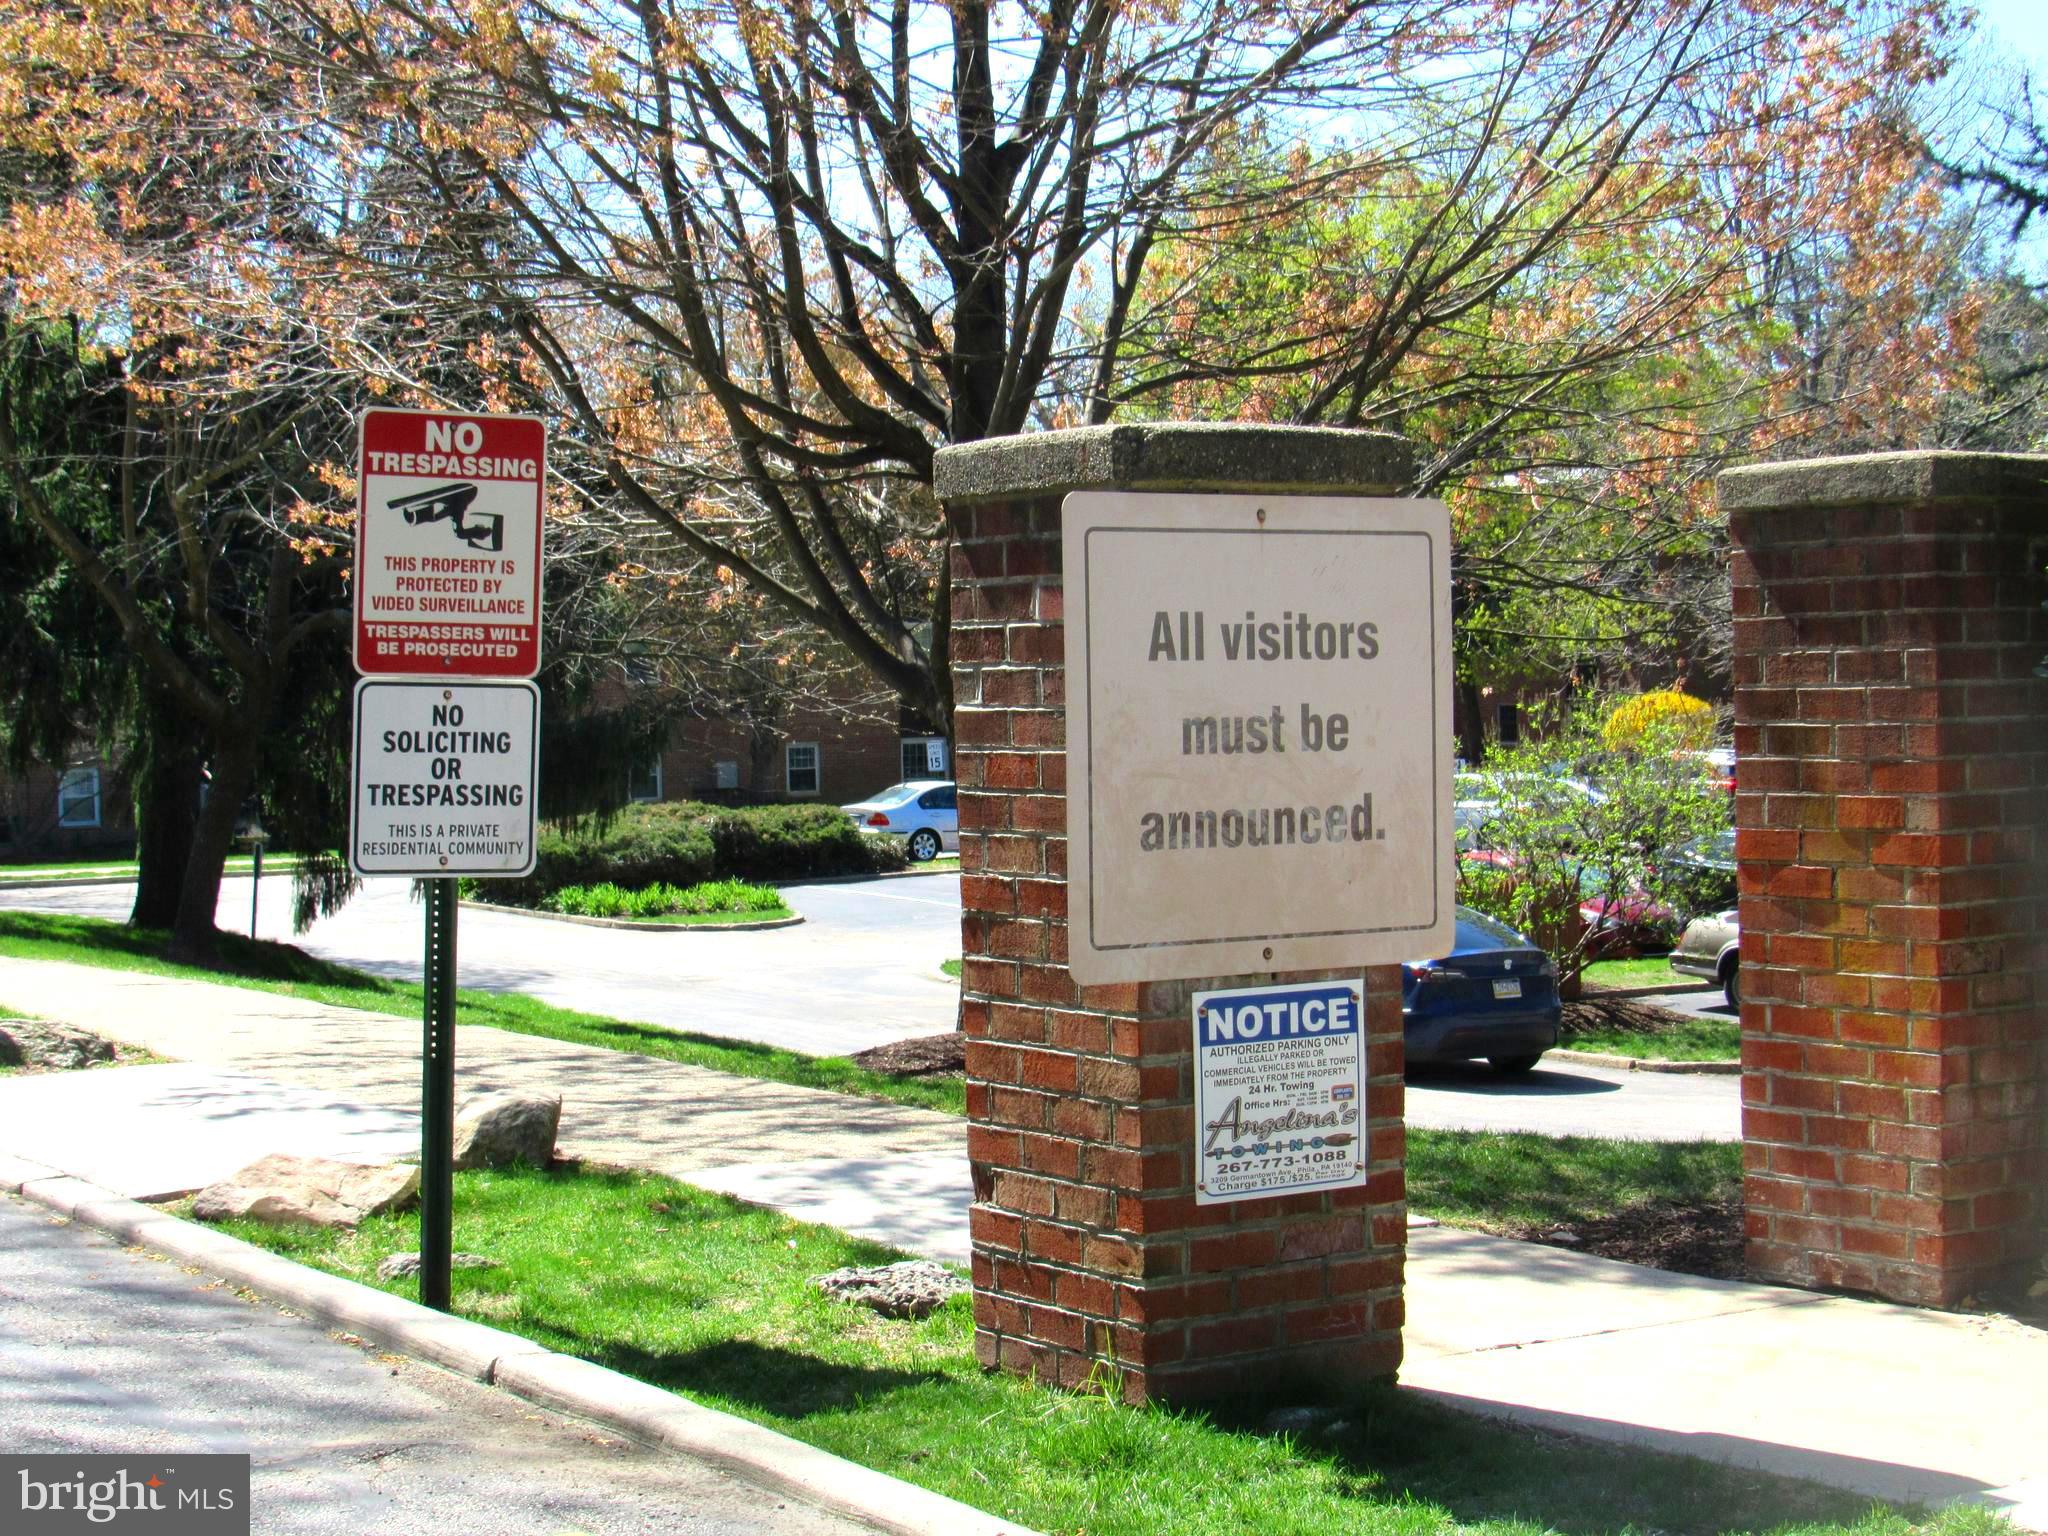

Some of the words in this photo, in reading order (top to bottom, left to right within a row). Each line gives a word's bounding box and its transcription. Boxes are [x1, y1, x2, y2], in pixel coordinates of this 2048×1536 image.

[425, 420, 483, 454] NO
[368, 451, 537, 478] TRESPASSING
[384, 556, 417, 572] THIS
[421, 557, 496, 574] PROPERTY
[501, 560, 515, 574] IS
[396, 577, 478, 593] PROTECTED
[483, 579, 502, 594] BY
[372, 596, 414, 611] VIDEO
[419, 597, 525, 614] SURVEILLANCE
[365, 624, 485, 640] TRESPASSERS
[490, 628, 530, 641] WILL
[1148, 610, 1204, 662] All
[1220, 610, 1379, 661] visitors
[377, 642, 399, 655] BE
[404, 643, 518, 657] PROSECUTED
[433, 704, 464, 727] NO
[1182, 705, 1285, 755] must
[1300, 703, 1349, 752] be
[383, 730, 511, 754] SOLICITING
[431, 757, 462, 780] OR
[930, 757, 941, 768] 15
[368, 784, 523, 807] TRESPASSING
[389, 824, 417, 837] THIS
[421, 824, 432, 837] IS
[437, 824, 445, 837] A
[450, 824, 499, 837] PRIVATE
[1140, 792, 1385, 852] announced.
[362, 842, 443, 855] RESIDENTIAL
[448, 842, 524, 855] COMMUNITY
[1208, 998, 1350, 1041] NOTICE
[1210, 1044, 1275, 1057] AUTHORIZED
[1278, 1039, 1321, 1051] PARKING
[1324, 1035, 1350, 1046] ONLY
[1237, 1055, 1278, 1064] ILLEGALLY
[1280, 1051, 1311, 1060] PARKED
[1313, 1049, 1324, 1057] OR
[1204, 1067, 1256, 1078] COMMERCIAL
[1258, 1063, 1295, 1073] VEHICLES
[1296, 1060, 1315, 1069] WILL
[1317, 1059, 1328, 1067] BE
[1329, 1056, 1356, 1065] TOWED
[1214, 1076, 1265, 1087] IMMEDIATELY
[1266, 1073, 1288, 1082] FROM
[1291, 1071, 1305, 1079] THE
[1307, 1067, 1347, 1078] PROPERTY
[1249, 1085, 1261, 1095] 24
[1264, 1084, 1277, 1093] Hr.
[1280, 1081, 1314, 1091] Towing
[1244, 1100, 1270, 1110] Office
[1273, 1099, 1290, 1107] Hrs:
[1205, 1095, 1359, 1150] Angelina's
[1215, 1136, 1325, 1160] TOWING
[1217, 1150, 1347, 1174] 267-773-1088
[1218, 1181, 1257, 1191] Charge
[1230, 1171, 1276, 1182] Germantown
